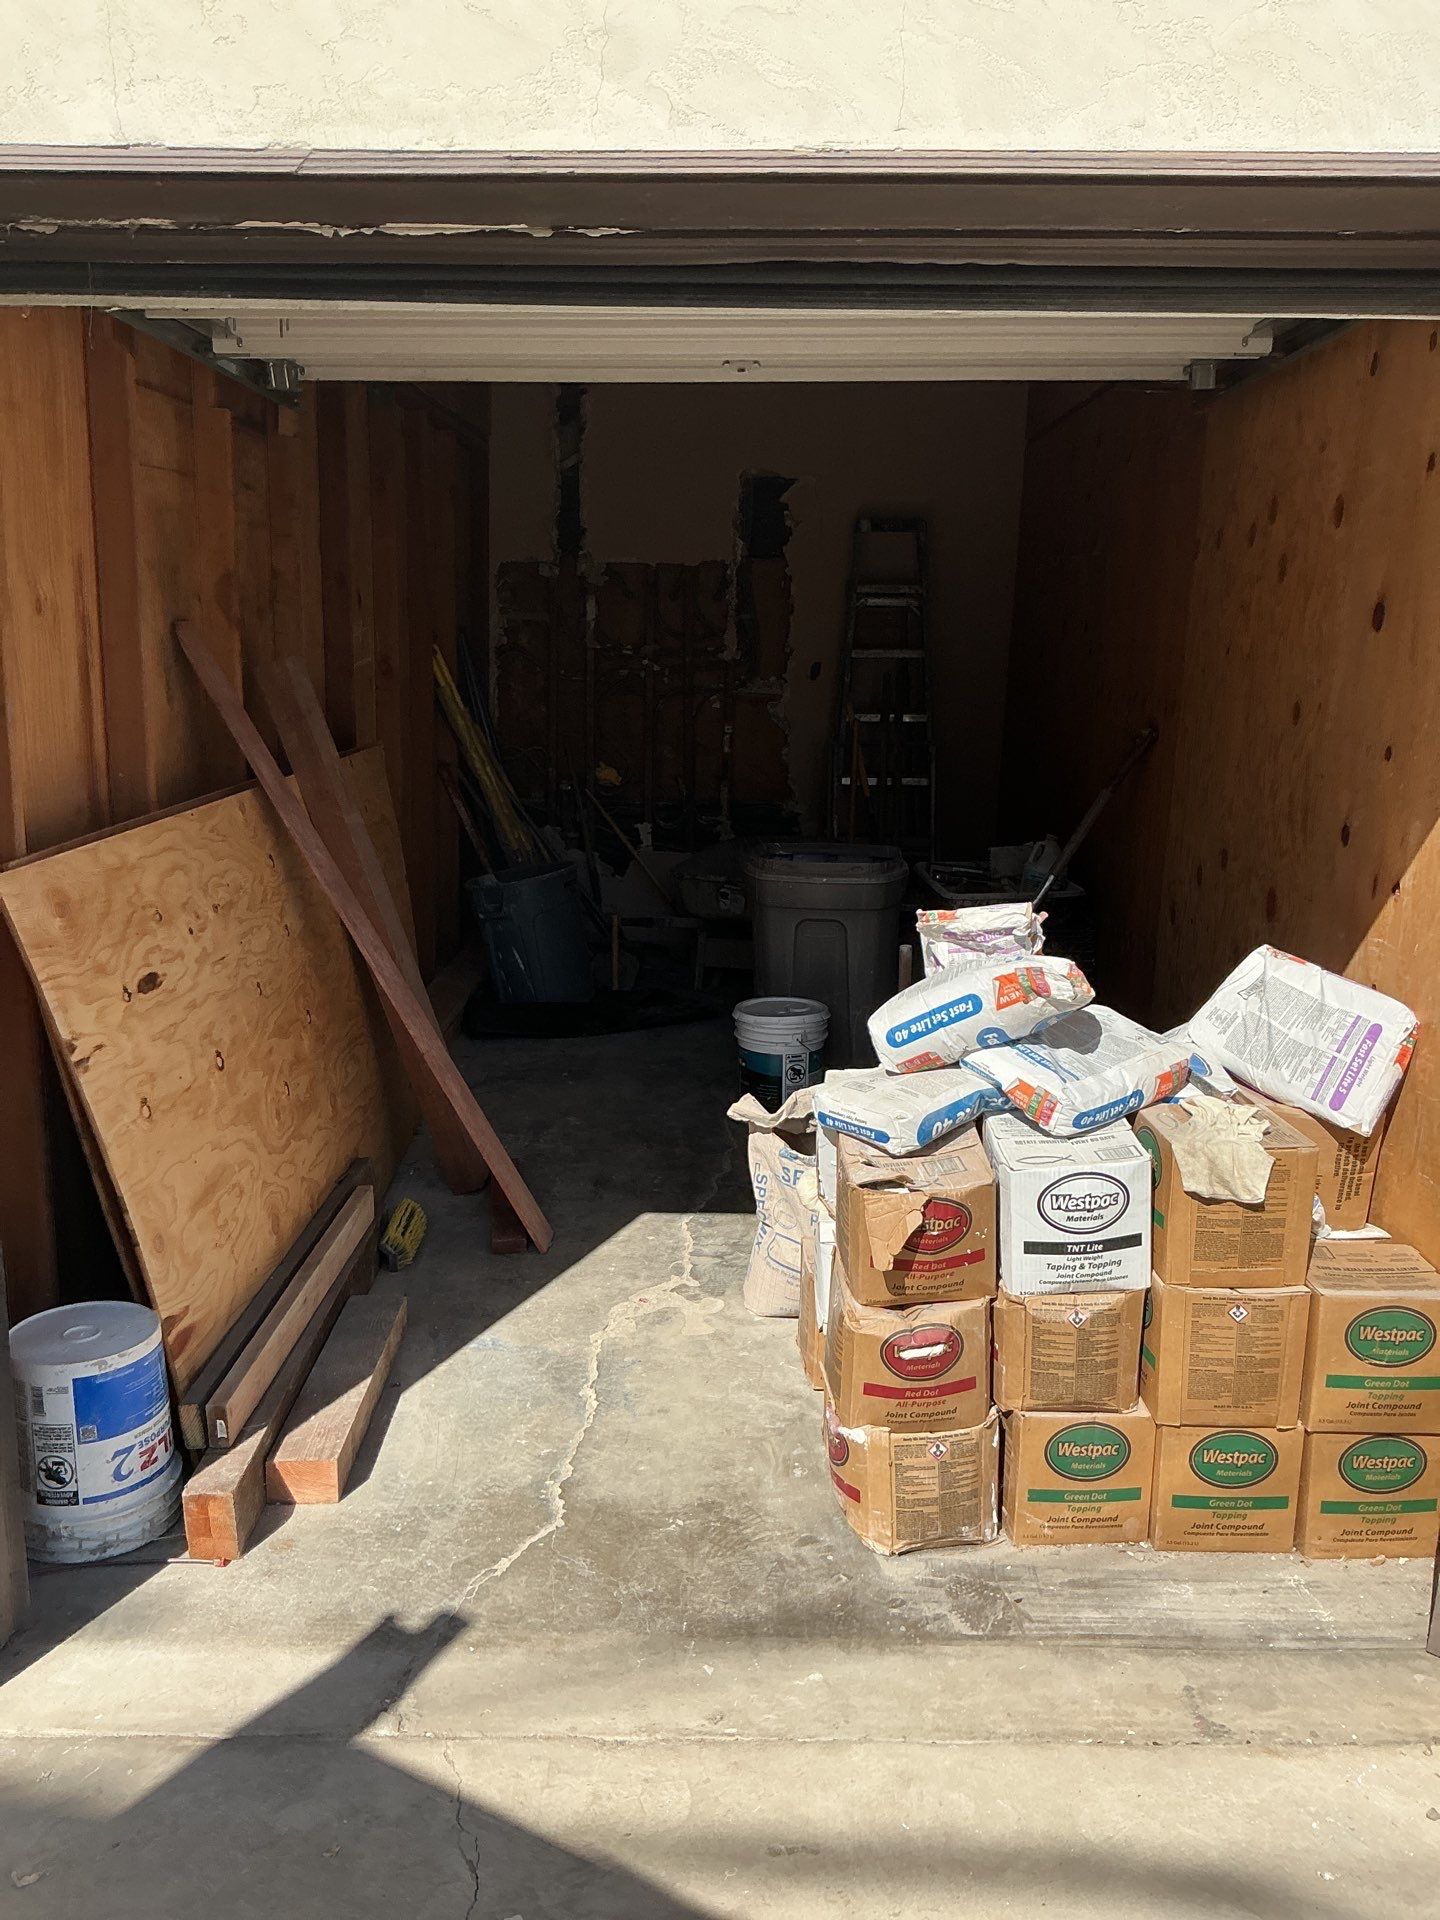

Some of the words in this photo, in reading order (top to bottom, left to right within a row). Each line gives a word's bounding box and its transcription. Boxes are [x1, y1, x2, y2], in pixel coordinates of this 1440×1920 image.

[1000, 990, 1025, 1004] NEW
[948, 1000, 974, 1020] Fast
[931, 1009, 950, 1025] Set
[910, 1016, 932, 1034] Lite
[894, 1029, 909, 1043] 40
[1358, 1039, 1373, 1058] Fast
[1351, 1057, 1363, 1071] Set
[1343, 1070, 1356, 1088] Lite
[1339, 1086, 1347, 1095] 5
[826, 1117, 835, 1126] 40
[835, 1121, 849, 1130] Lite
[1081, 1116, 1094, 1125] 40
[850, 1125, 862, 1135] Set
[932, 1120, 953, 1137] 40
[861, 1129, 875, 1139] Fast
[1050, 1192, 1119, 1213] Westpac
[1066, 1214, 1104, 1222] Materials
[917, 1214, 961, 1235] stpac
[912, 1236, 949, 1244] Materials
[1066, 1245, 1085, 1253] TNT
[1087, 1243, 1104, 1252] Lite
[912, 1263, 931, 1271] Red
[931, 1262, 947, 1270] Dot
[1046, 1262, 1076, 1272] Taping
[1088, 1259, 1122, 1270] Topping
[904, 1271, 955, 1281] All-Purpose
[1075, 1269, 1112, 1279] Compound
[892, 1283, 915, 1291] Joint
[916, 1279, 964, 1292] Compound
[1359, 1325, 1425, 1345] Westpac
[1372, 1348, 1409, 1356] Materials
[906, 1362, 941, 1371] Materials
[1364, 1379, 1391, 1388] Green
[1393, 1379, 1409, 1387] Dot
[904, 1390, 922, 1398] Red
[923, 1389, 939, 1397] Dot
[1367, 1391, 1404, 1401] Topping
[895, 1399, 947, 1409] All-Purpose
[1345, 1401, 1370, 1410] Joint
[1371, 1401, 1422, 1411] Compound
[885, 1411, 908, 1419] Joint
[909, 1407, 957, 1420] Compound
[138, 1427, 172, 1472] ILZ
[1057, 1441, 1120, 1459] Westpac
[111, 1443, 137, 1482] 2
[1202, 1448, 1266, 1467] Westpac
[1070, 1462, 1106, 1470] Materials
[1352, 1455, 1416, 1471] Westpac
[1215, 1469, 1252, 1477] Materials
[1066, 1505, 1102, 1514] Topping
[1358, 1504, 1384, 1512] Green
[1385, 1504, 1402, 1512] Dot
[1071, 1515, 1118, 1525] Compound
[1211, 1512, 1248, 1520] Topping
[1361, 1517, 1397, 1525] Topping
[1216, 1523, 1264, 1532] Compound
[1365, 1527, 1414, 1537] Compound
